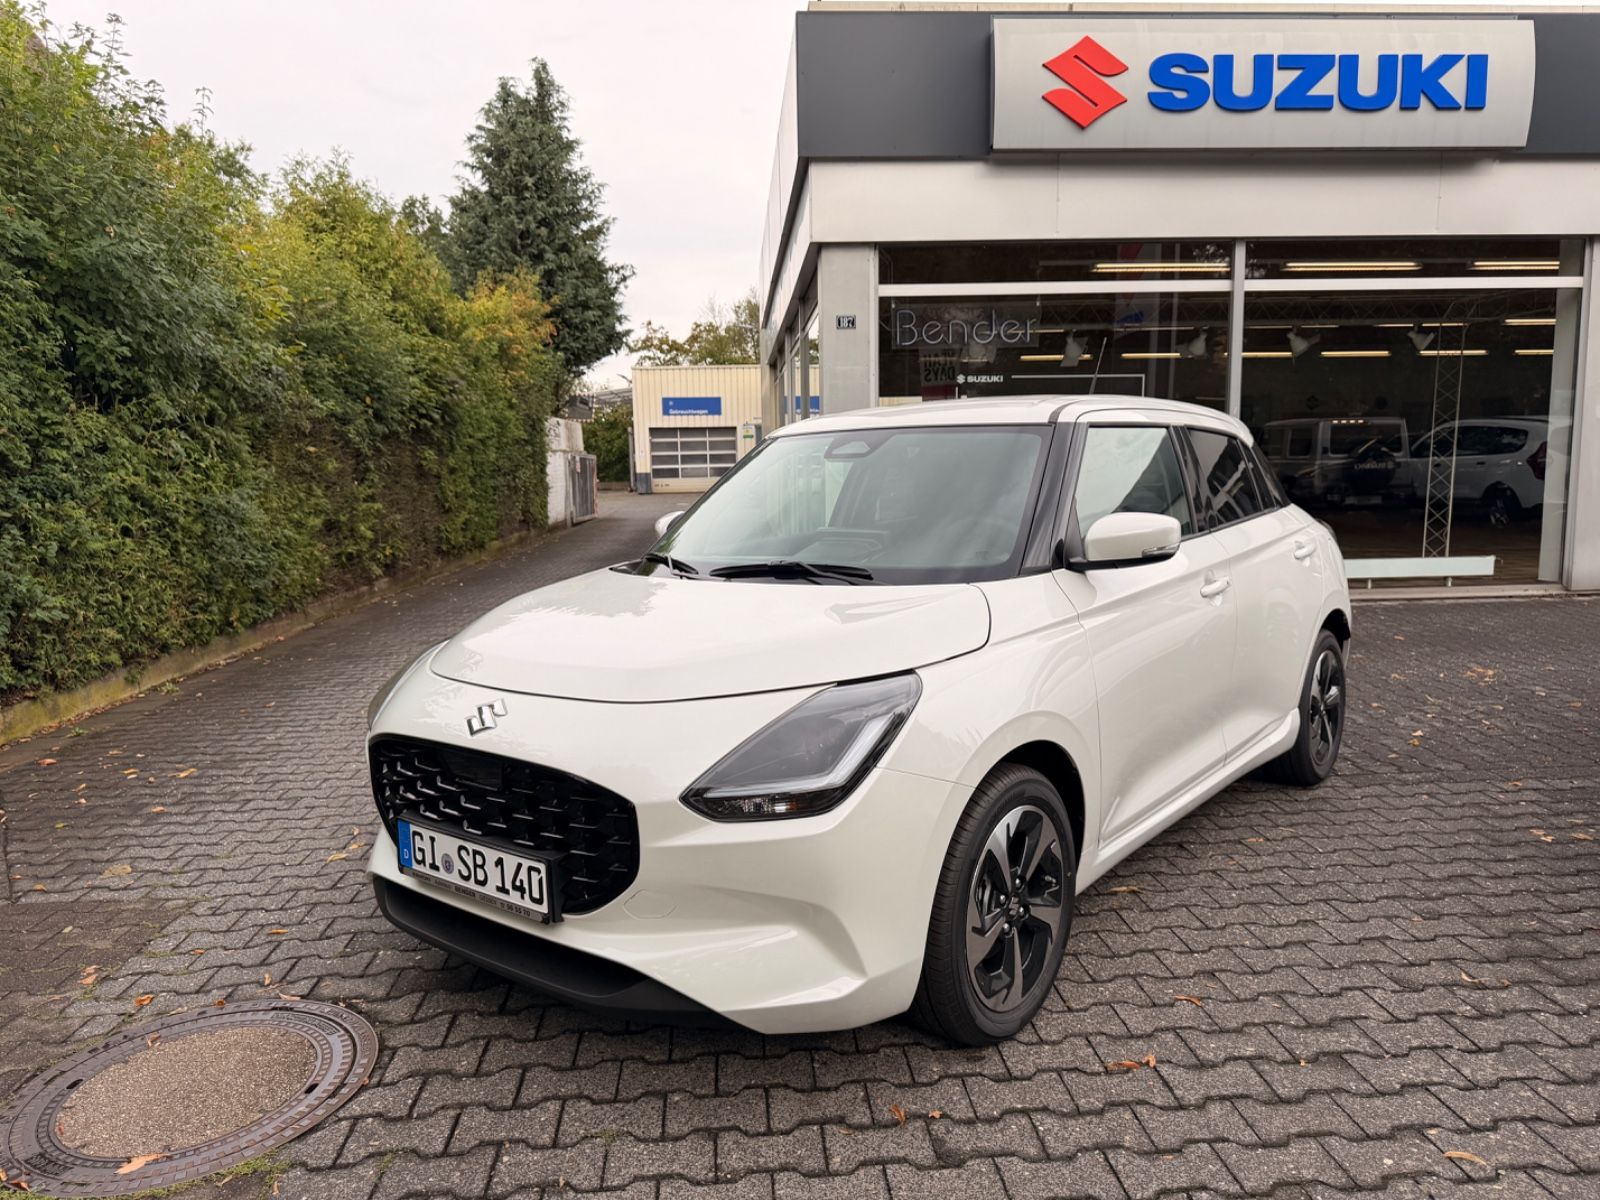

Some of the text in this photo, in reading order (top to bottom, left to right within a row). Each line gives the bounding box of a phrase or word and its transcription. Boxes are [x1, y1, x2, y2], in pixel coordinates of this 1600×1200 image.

[1147, 53, 1488, 112] SUZUKI
[896, 309, 1038, 346] Bender
[967, 375, 1004, 383] SUZUKI
[403, 849, 409, 859] D
[412, 830, 543, 905] GI SB 140
